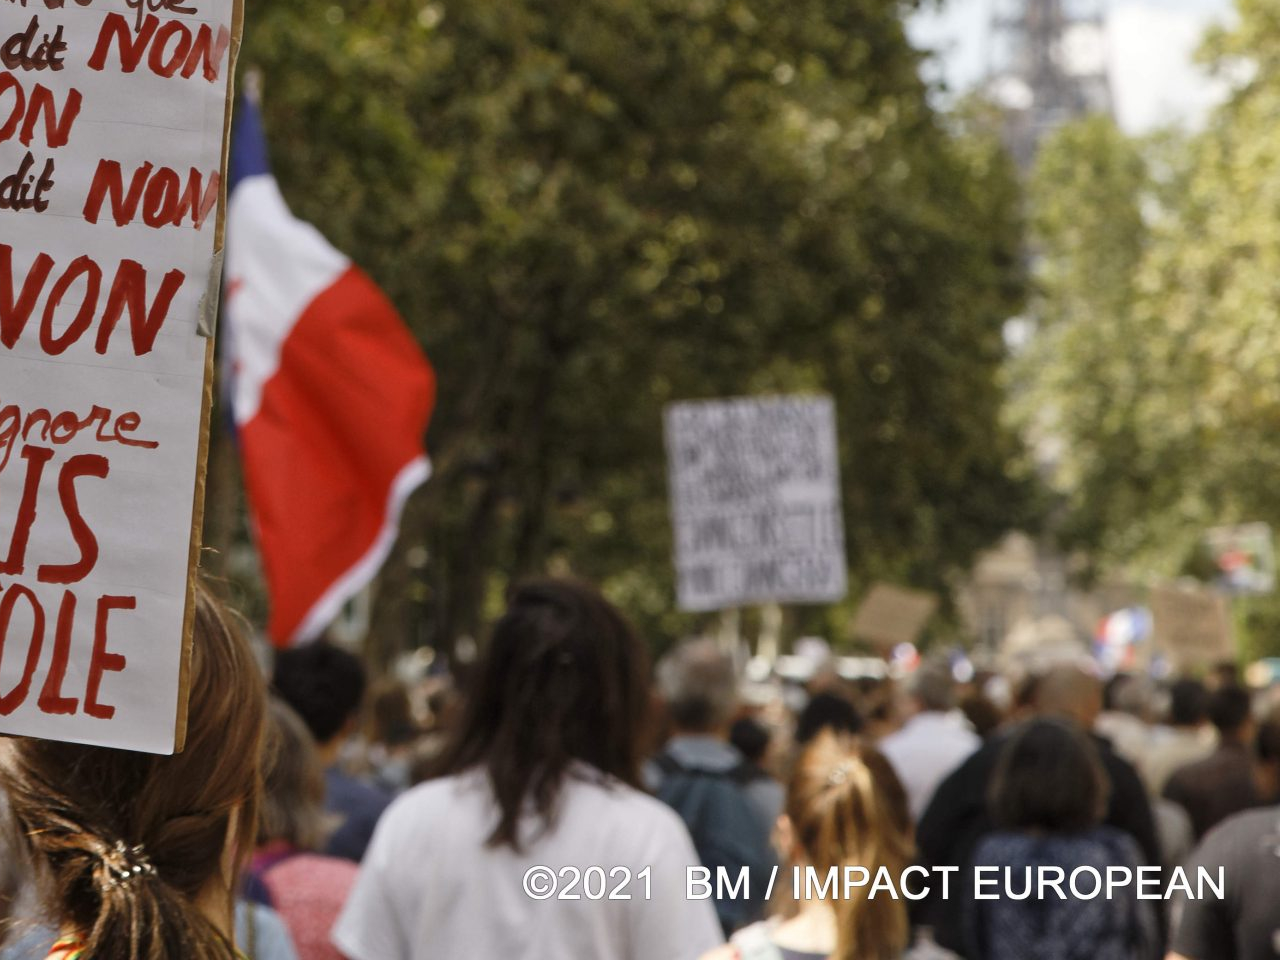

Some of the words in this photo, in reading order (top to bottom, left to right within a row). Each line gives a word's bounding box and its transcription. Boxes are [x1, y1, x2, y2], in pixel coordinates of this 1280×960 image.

[0, 15, 68, 71] dit
[87, 12, 228, 83] NON
[82, 159, 220, 230] NON
